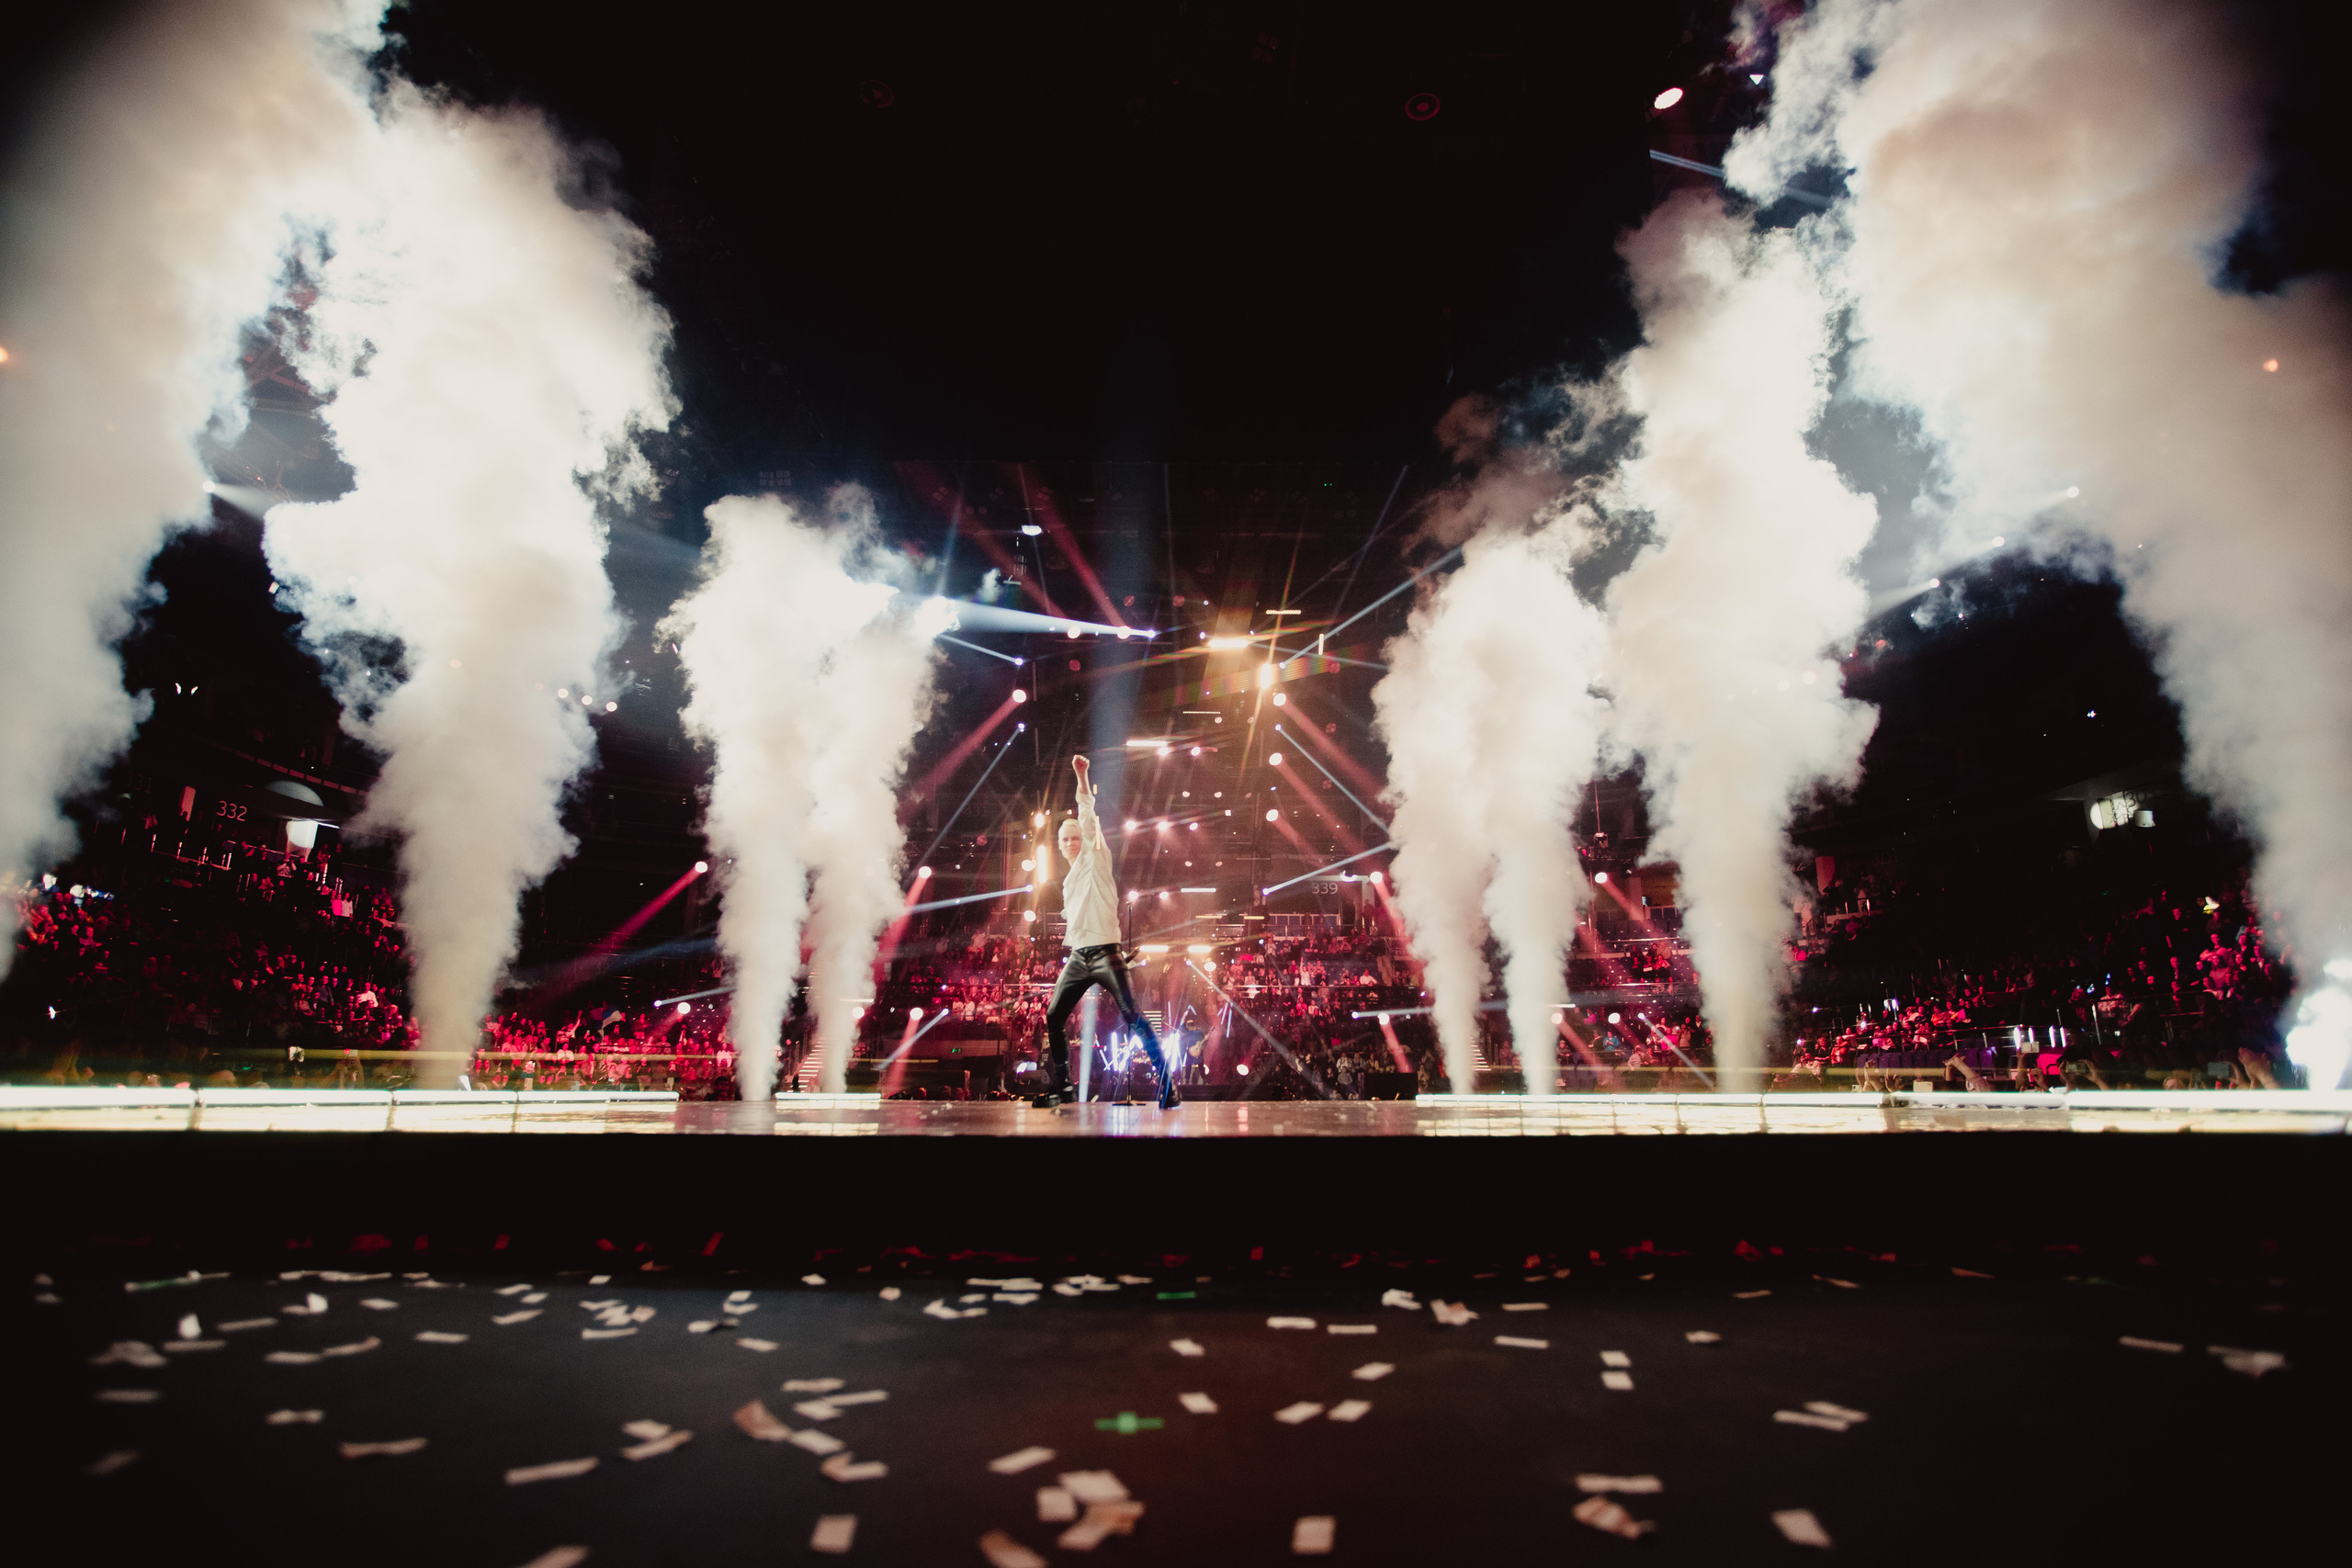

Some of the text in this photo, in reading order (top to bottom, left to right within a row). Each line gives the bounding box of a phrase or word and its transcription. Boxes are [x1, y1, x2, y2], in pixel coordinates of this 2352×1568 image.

[122, 770, 153, 795] 331
[216, 799, 248, 822] 332
[1311, 882, 1339, 895] 339
